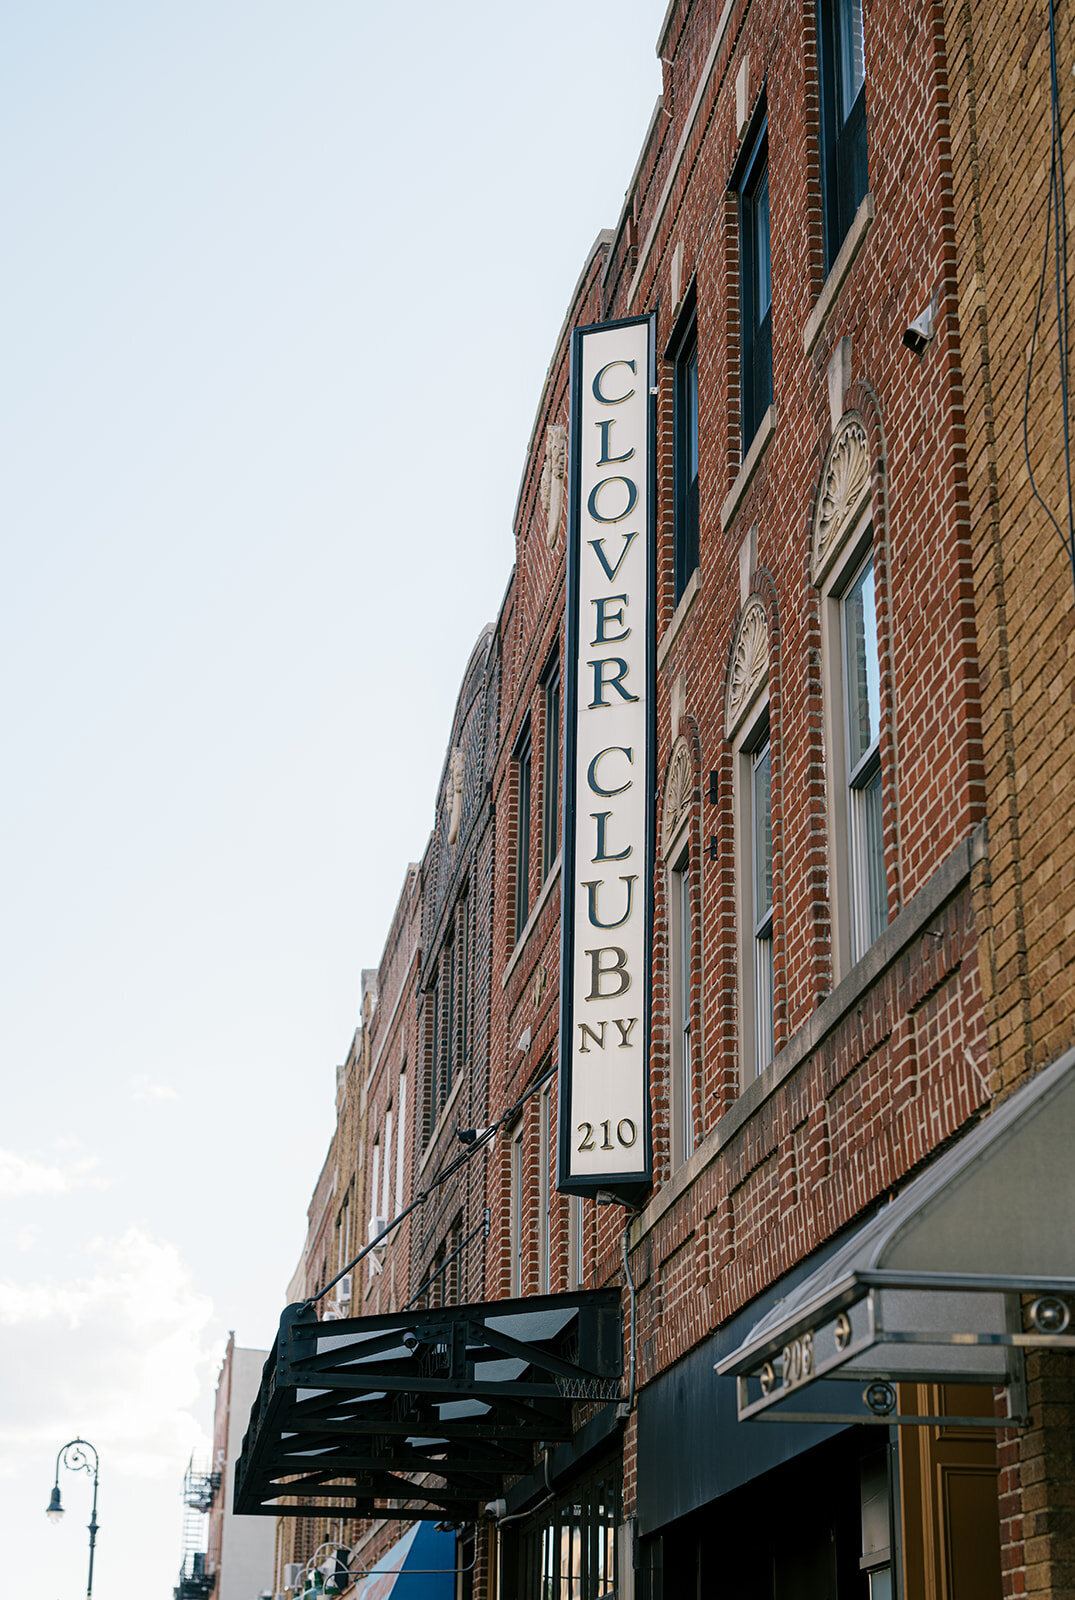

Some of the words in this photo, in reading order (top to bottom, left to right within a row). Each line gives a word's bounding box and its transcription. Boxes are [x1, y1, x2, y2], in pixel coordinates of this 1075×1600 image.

[587, 359, 640, 710] CLOVER
[580, 745, 638, 1002] CLUB
[577, 1017, 638, 1054] NY
[576, 1117, 638, 1153] 210
[782, 1331, 814, 1390] 206
